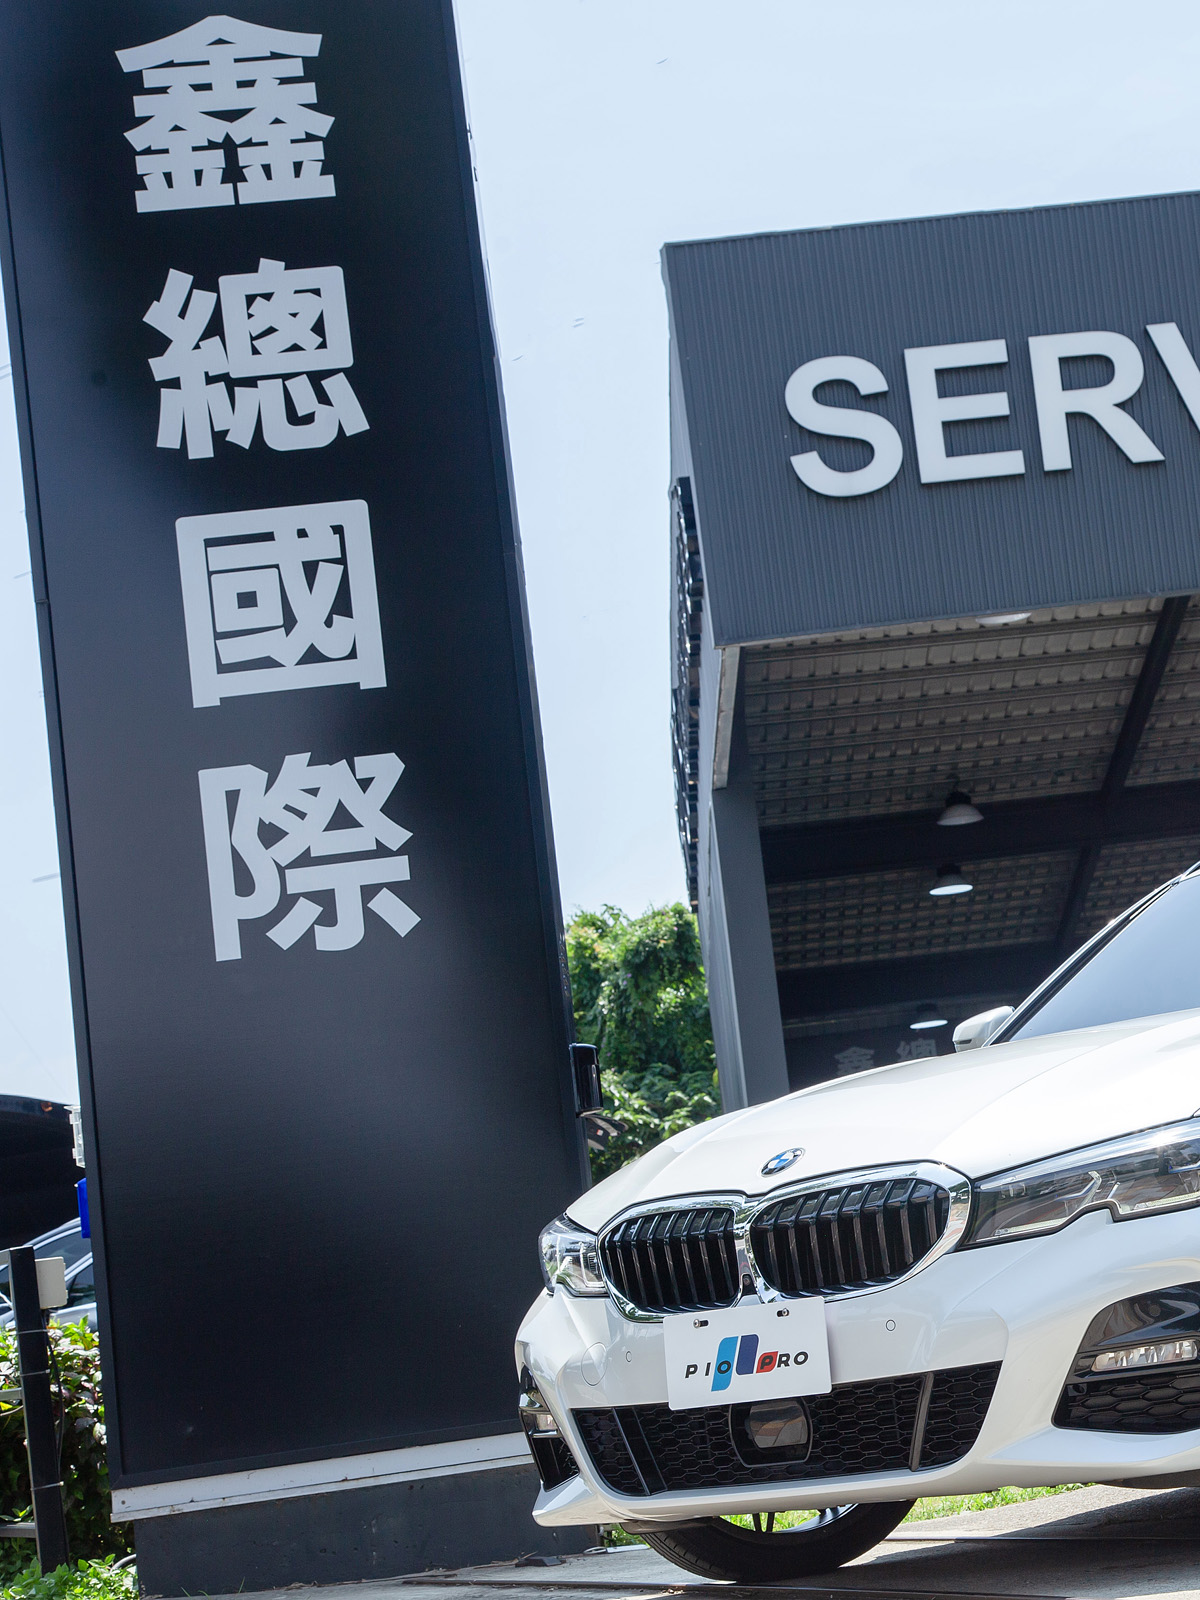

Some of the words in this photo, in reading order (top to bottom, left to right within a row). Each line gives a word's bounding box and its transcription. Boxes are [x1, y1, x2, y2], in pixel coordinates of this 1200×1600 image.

[115, 15, 421, 962] 鑫總國際
[685, 1360, 732, 1379] PIO
[760, 1351, 809, 1370] PRO
